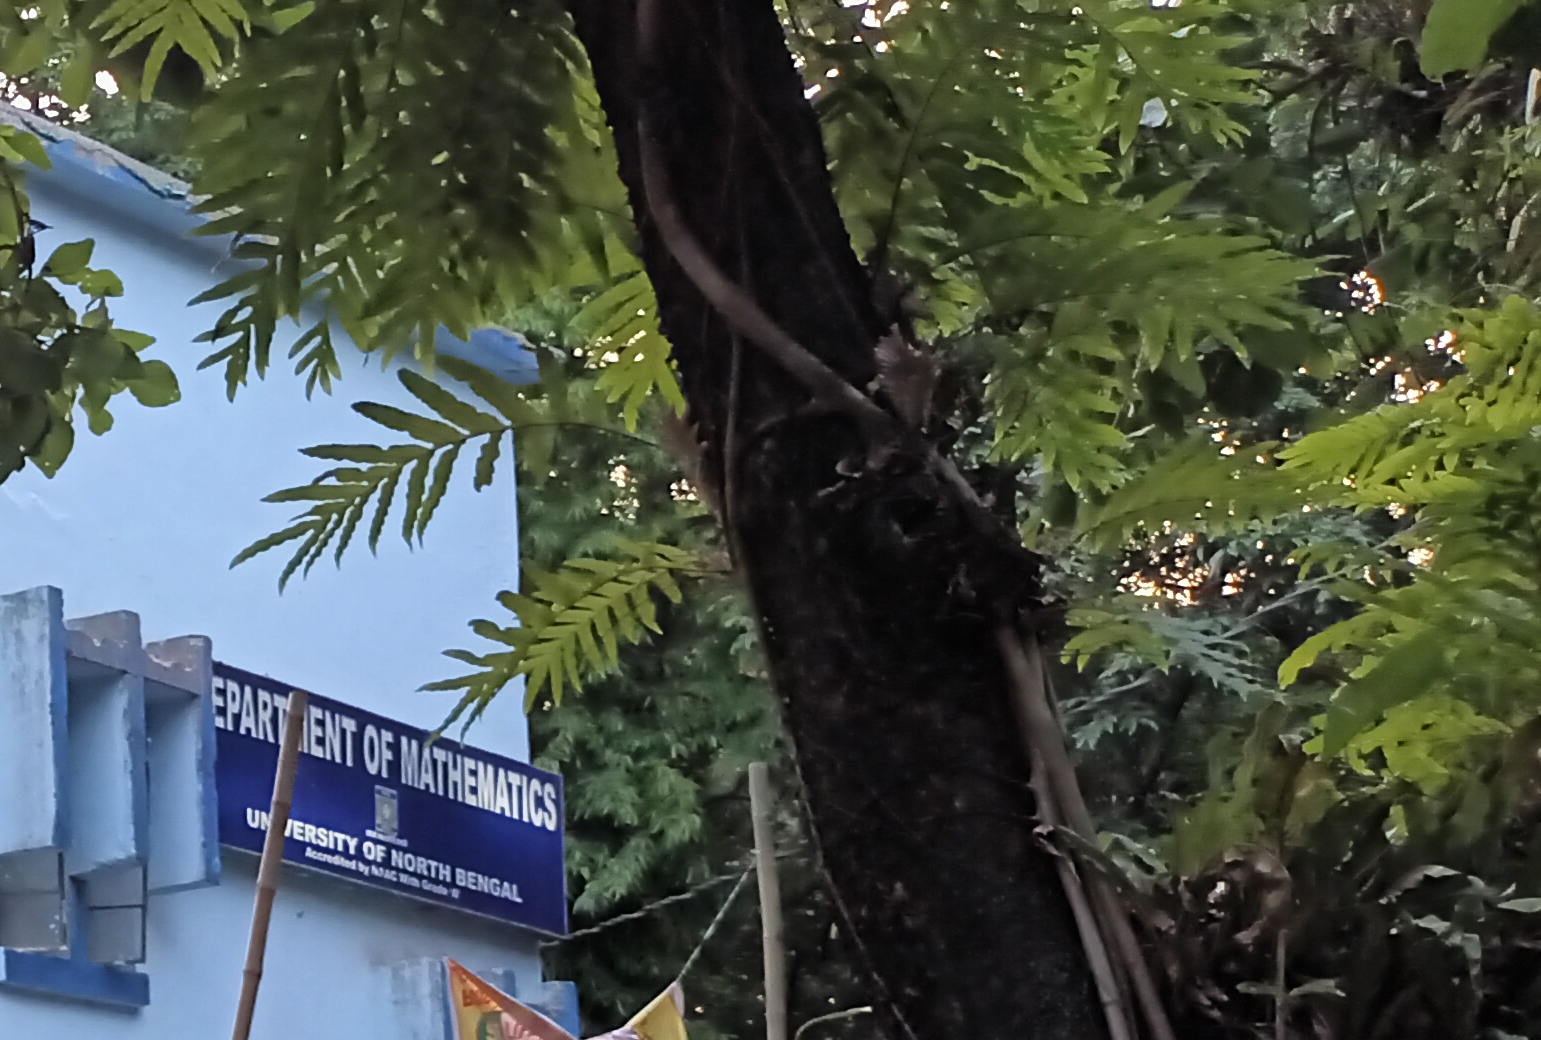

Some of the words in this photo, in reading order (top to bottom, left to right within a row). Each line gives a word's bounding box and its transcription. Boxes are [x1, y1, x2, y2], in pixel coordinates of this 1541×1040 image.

[211, 675, 357, 767] EPARTENT
[363, 723, 394, 778] OF
[400, 735, 558, 832] MATHEMATICS
[246, 807, 359, 855] UNVERSITY
[362, 841, 387, 862] OF
[390, 849, 452, 883] NORTH
[454, 867, 523, 903] BENGAL
